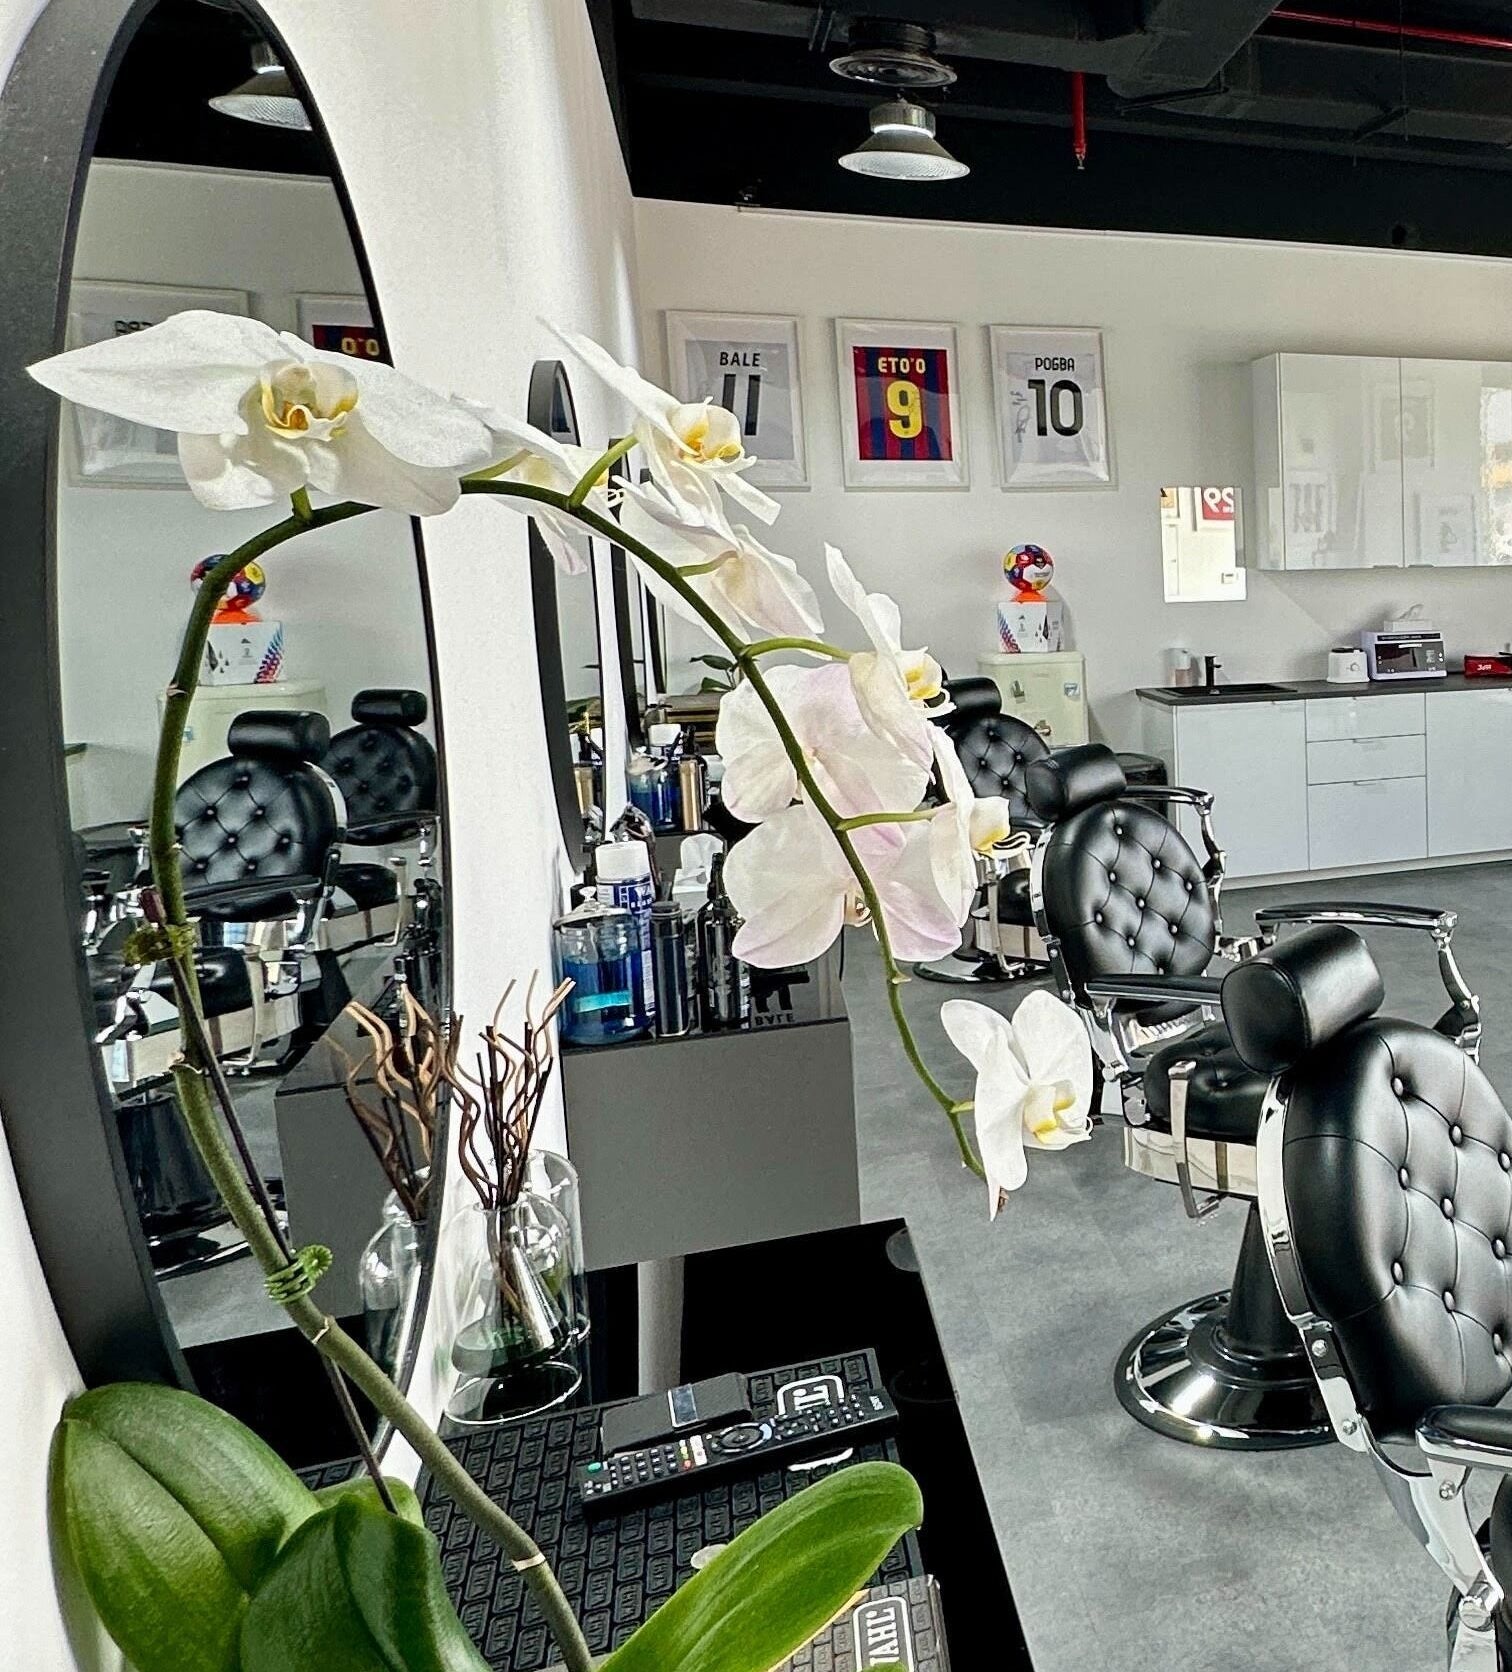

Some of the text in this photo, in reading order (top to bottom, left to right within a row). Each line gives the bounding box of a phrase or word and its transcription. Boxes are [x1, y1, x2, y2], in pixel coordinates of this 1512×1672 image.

[719, 351, 761, 367] BALE
[877, 357, 926, 374] ETO'O
[1034, 357, 1075, 371] POGBA
[721, 373, 761, 436] 11
[886, 380, 922, 438] 9
[1027, 378, 1084, 437] 10
